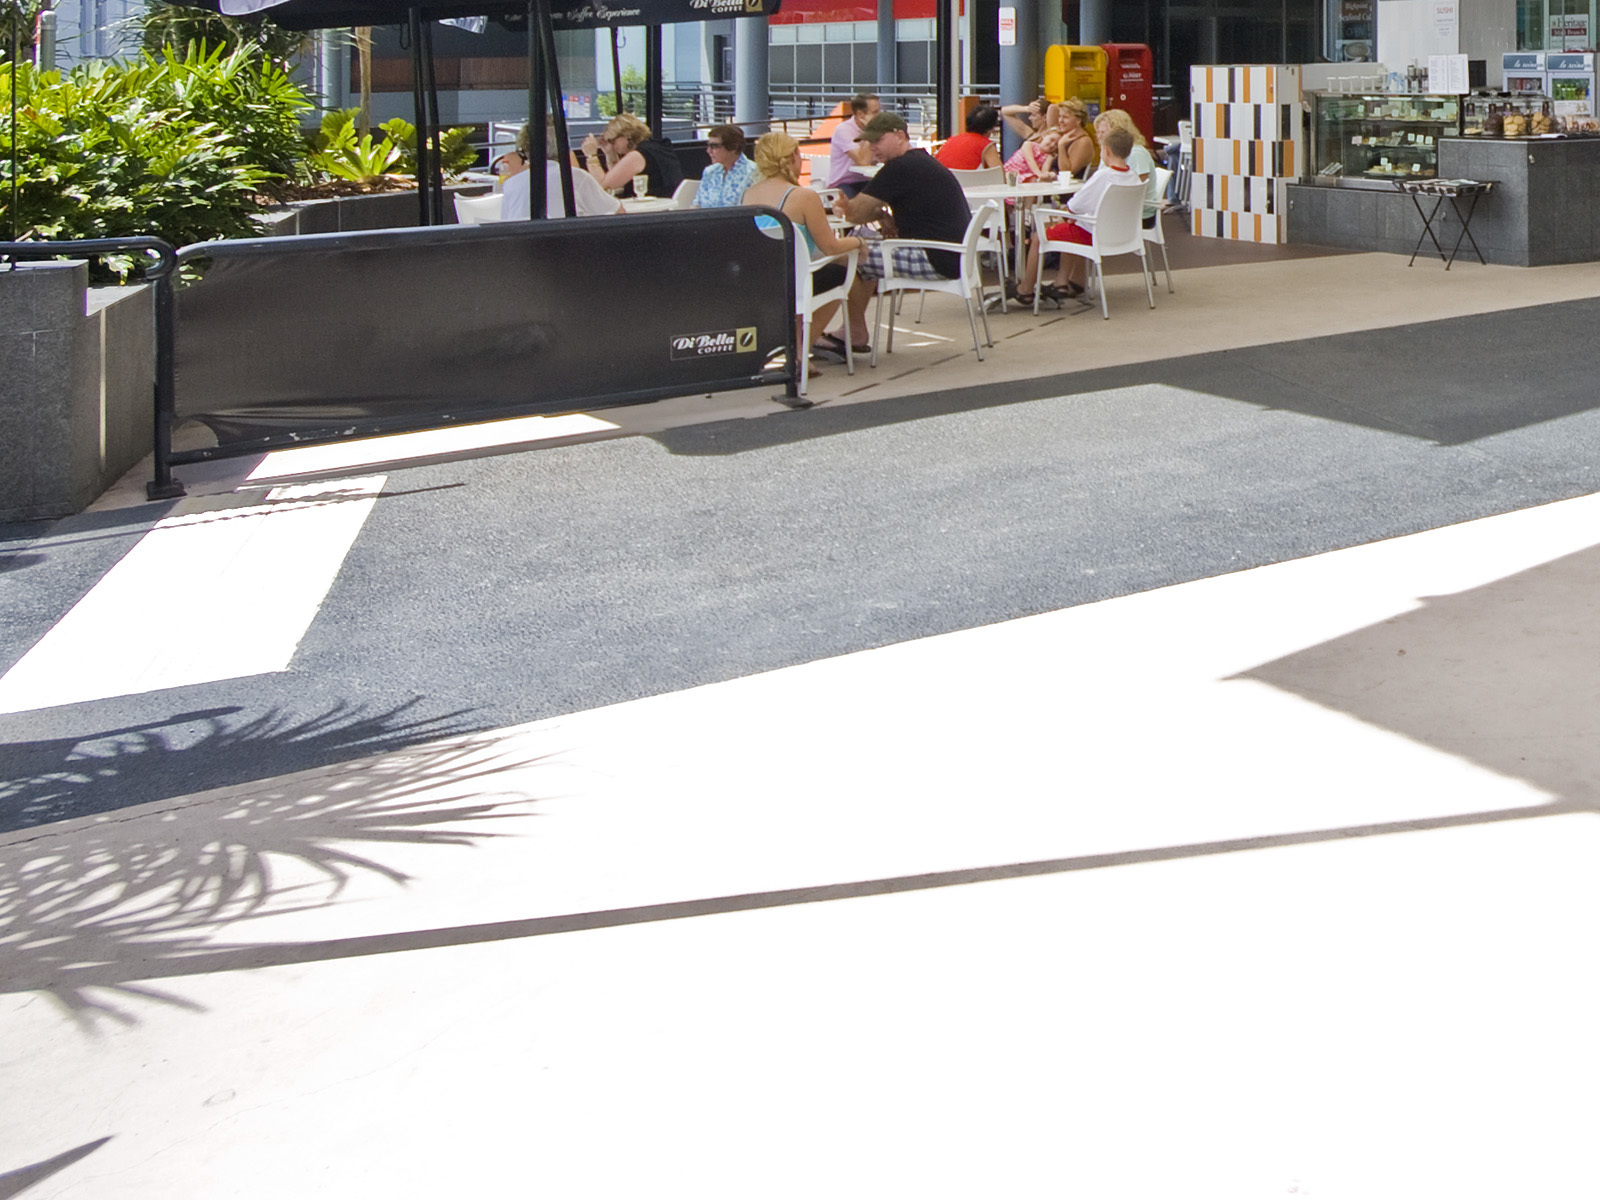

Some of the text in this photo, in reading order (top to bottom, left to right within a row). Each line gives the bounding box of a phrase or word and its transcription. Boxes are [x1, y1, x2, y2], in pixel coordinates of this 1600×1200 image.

[596, 5, 641, 21] Experience
[711, 4, 743, 14] COFFEE
[697, 344, 734, 355] COFFEE
